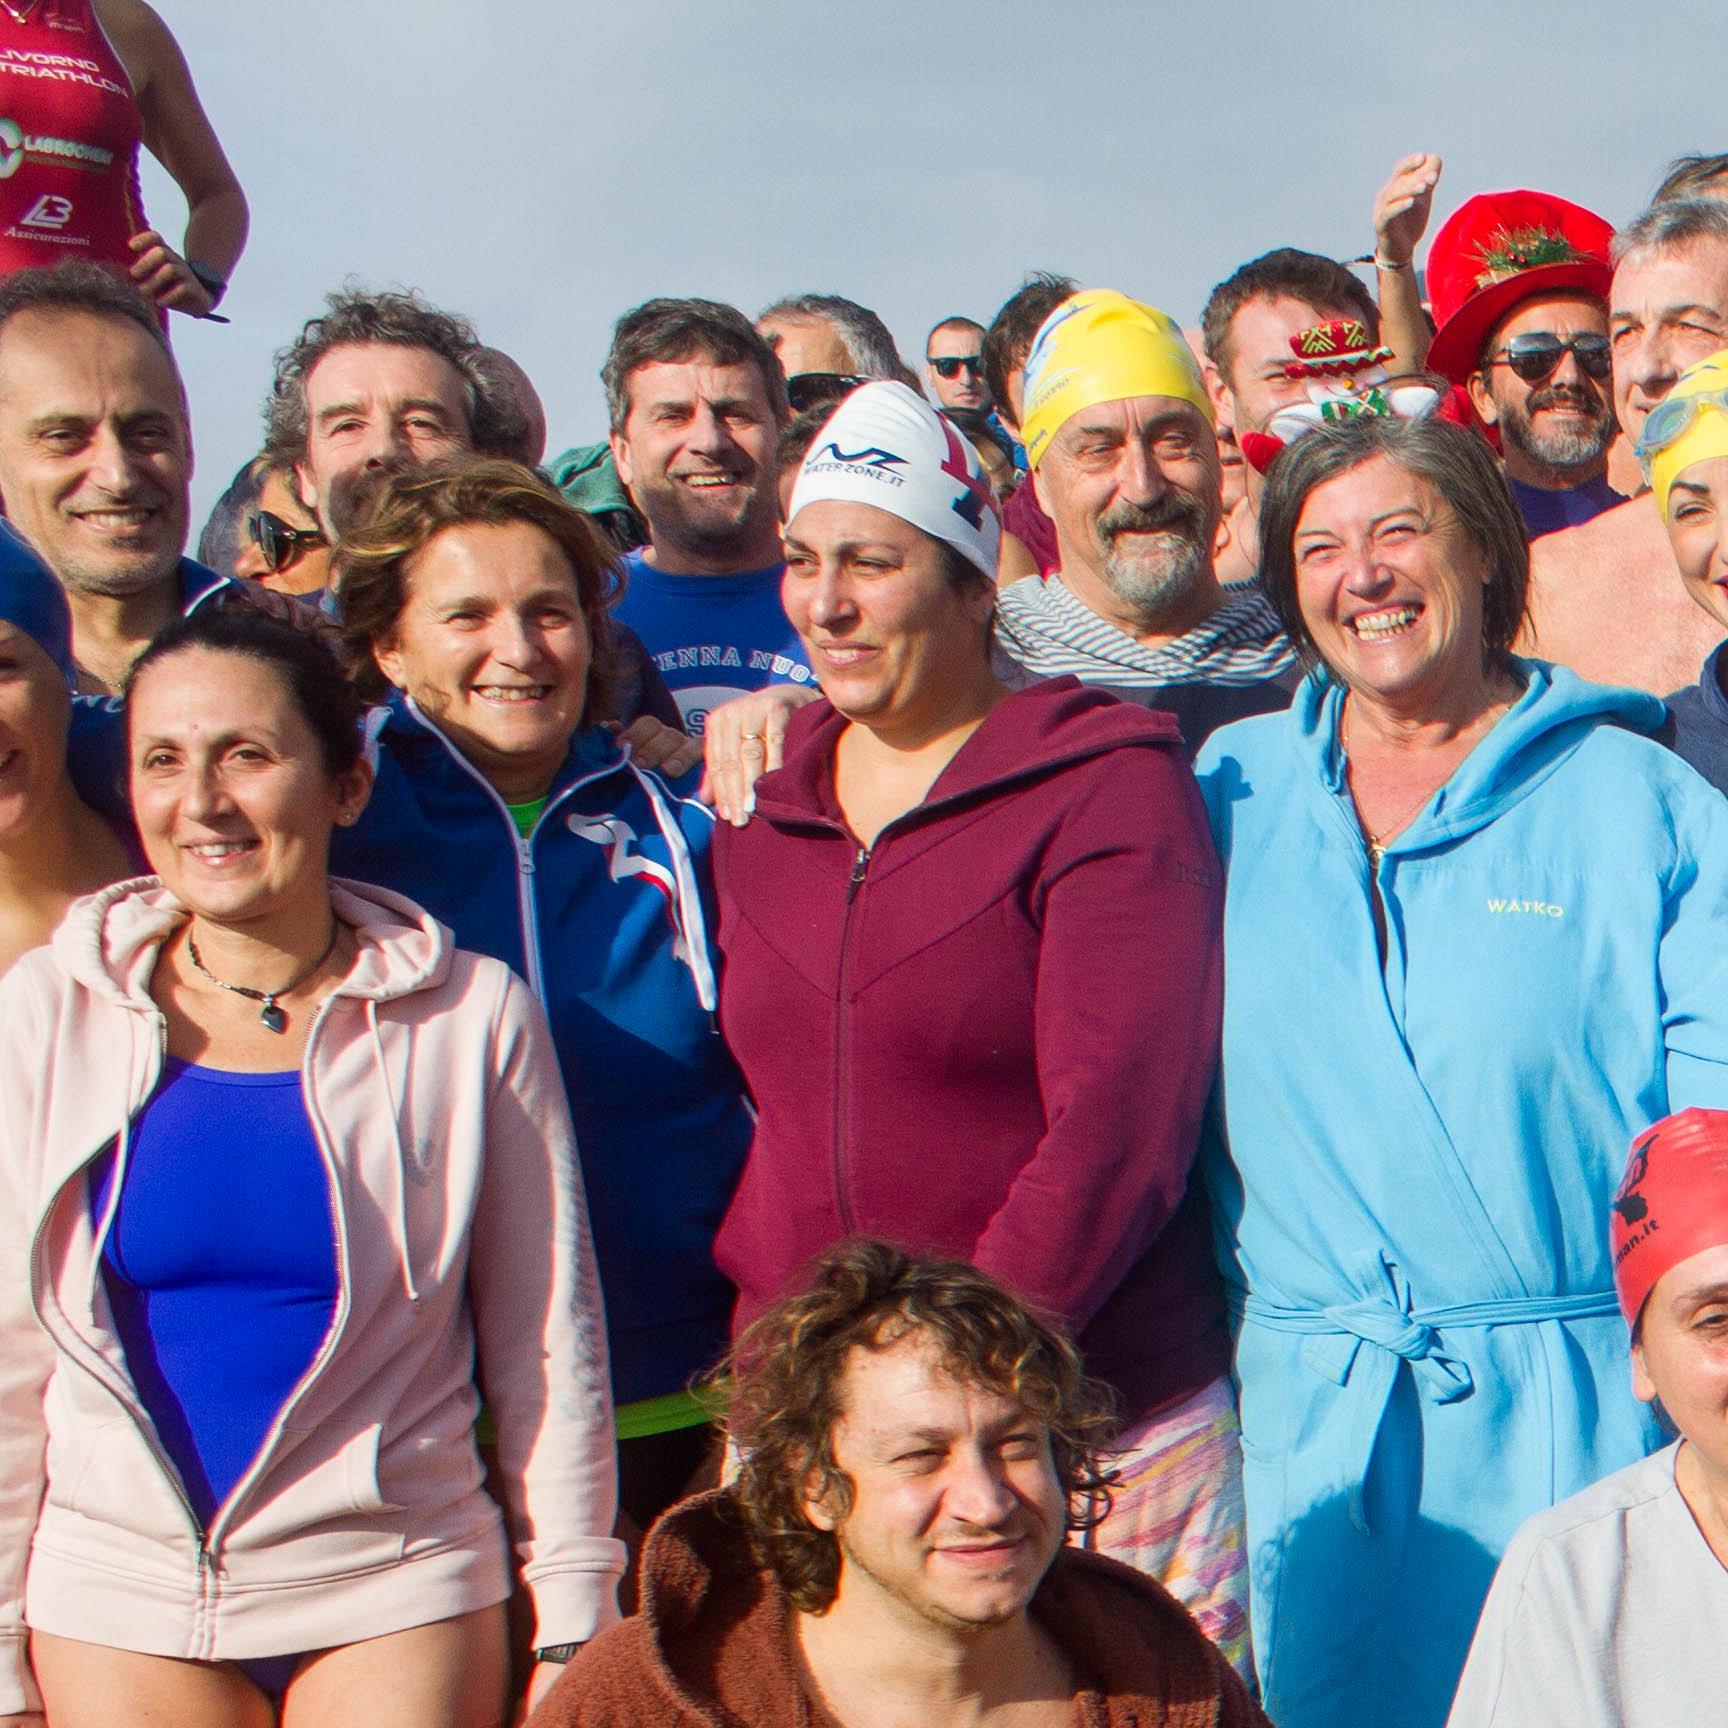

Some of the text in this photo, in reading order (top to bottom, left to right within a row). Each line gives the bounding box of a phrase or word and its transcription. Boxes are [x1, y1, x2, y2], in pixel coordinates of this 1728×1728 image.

[4, 226, 90, 246] Assicurazioni
[652, 646, 821, 683] ENNA NUO
[1487, 898, 1564, 918] WATKO
